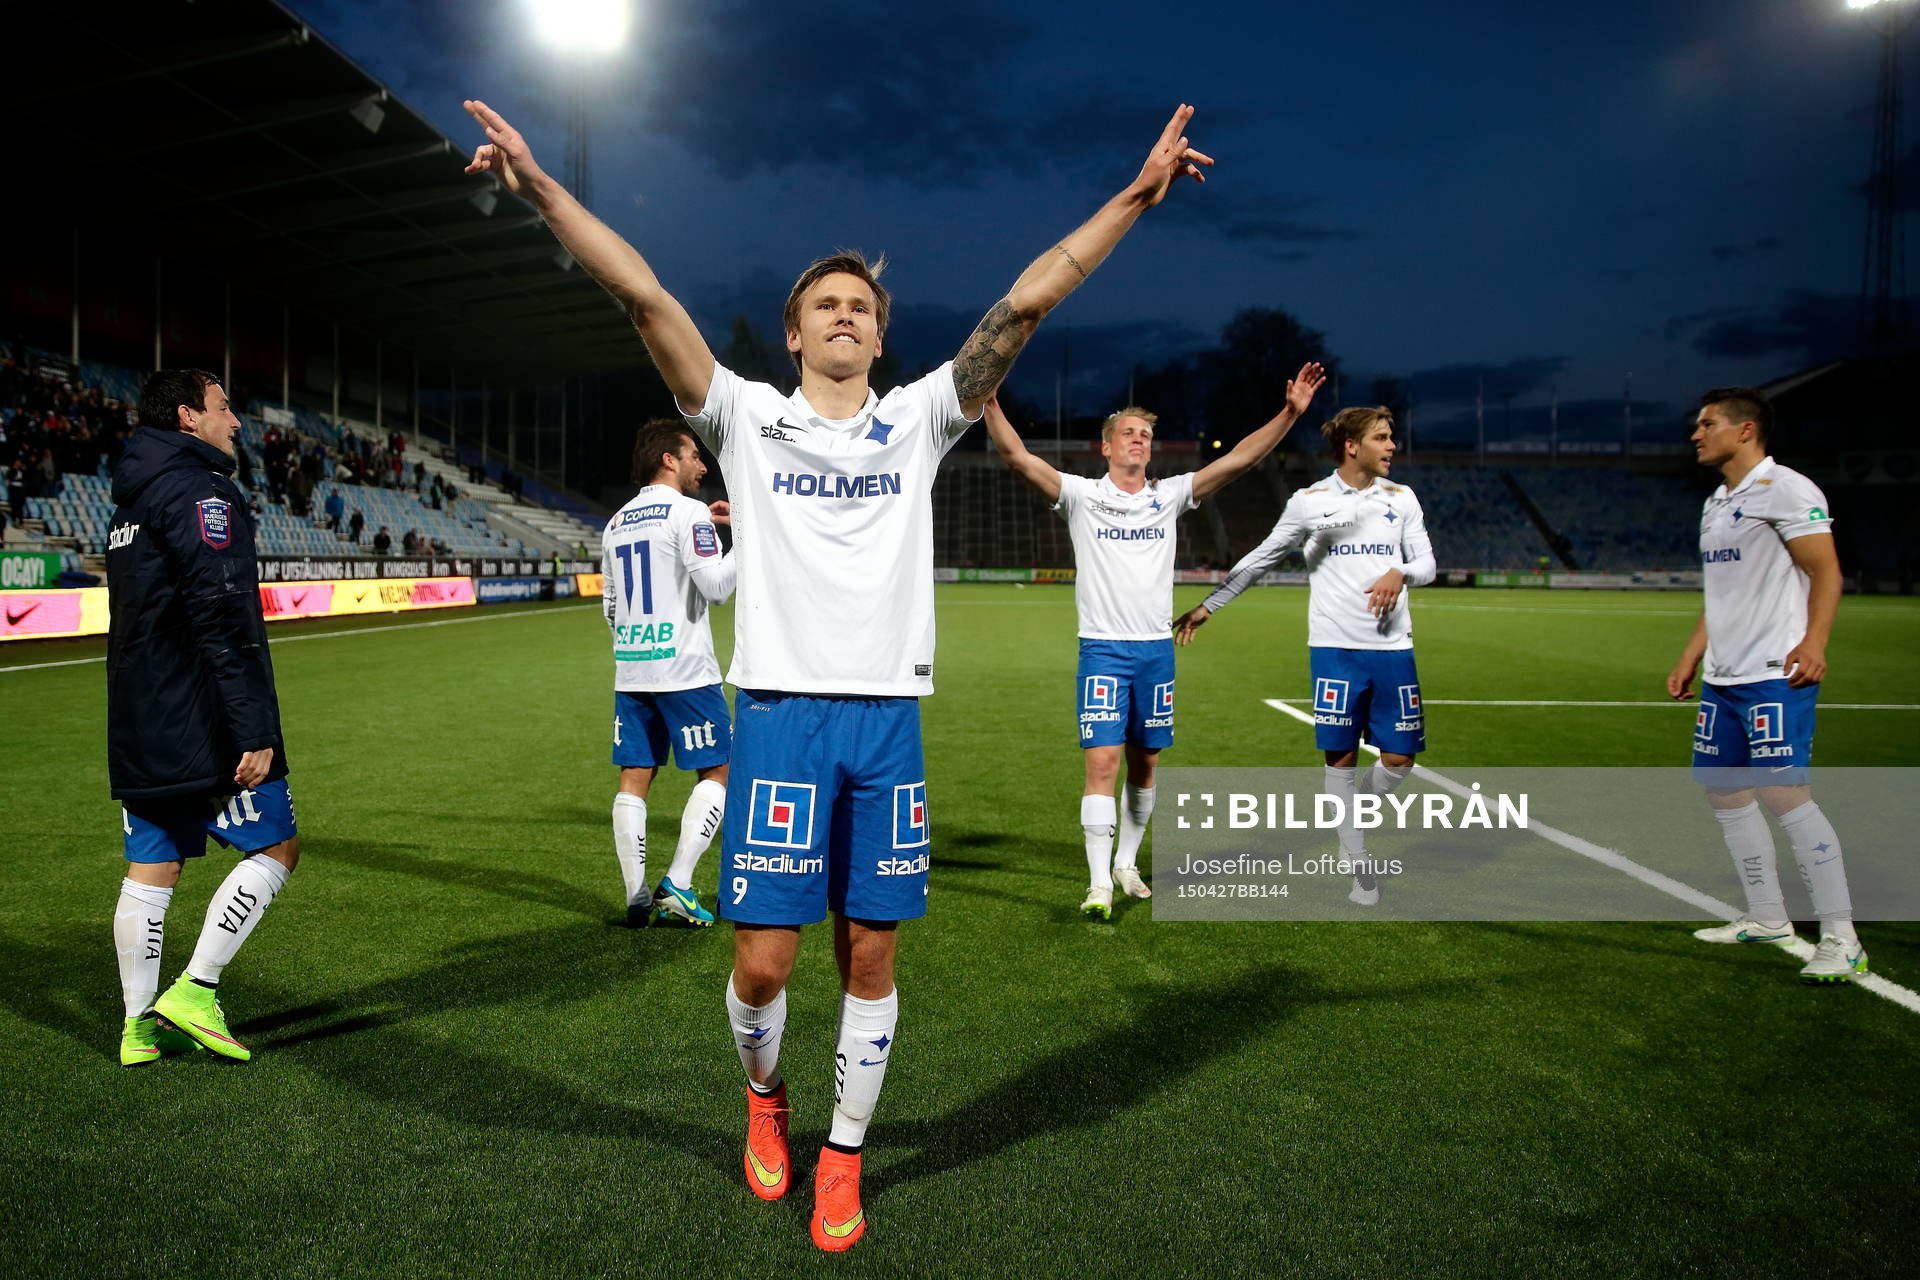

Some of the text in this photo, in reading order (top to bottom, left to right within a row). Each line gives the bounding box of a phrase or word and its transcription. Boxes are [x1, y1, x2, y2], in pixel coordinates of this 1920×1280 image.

[772, 472, 901, 498] HOLMEN
[1096, 527, 1165, 541] HOLMEN
[1316, 521, 1353, 531] stadium
[1328, 543, 1394, 556] HOLMEN
[1701, 548, 1741, 563] LMEN
[615, 540, 654, 616] 11
[1080, 710, 1120, 723] stadium
[1080, 723, 1093, 740] 16
[733, 851, 824, 874] stadium
[876, 853, 930, 876] stadiu
[1743, 855, 1765, 886] SITA
[732, 876, 748, 905] 9
[217, 885, 257, 935] SITA
[144, 918, 163, 961] SITA
